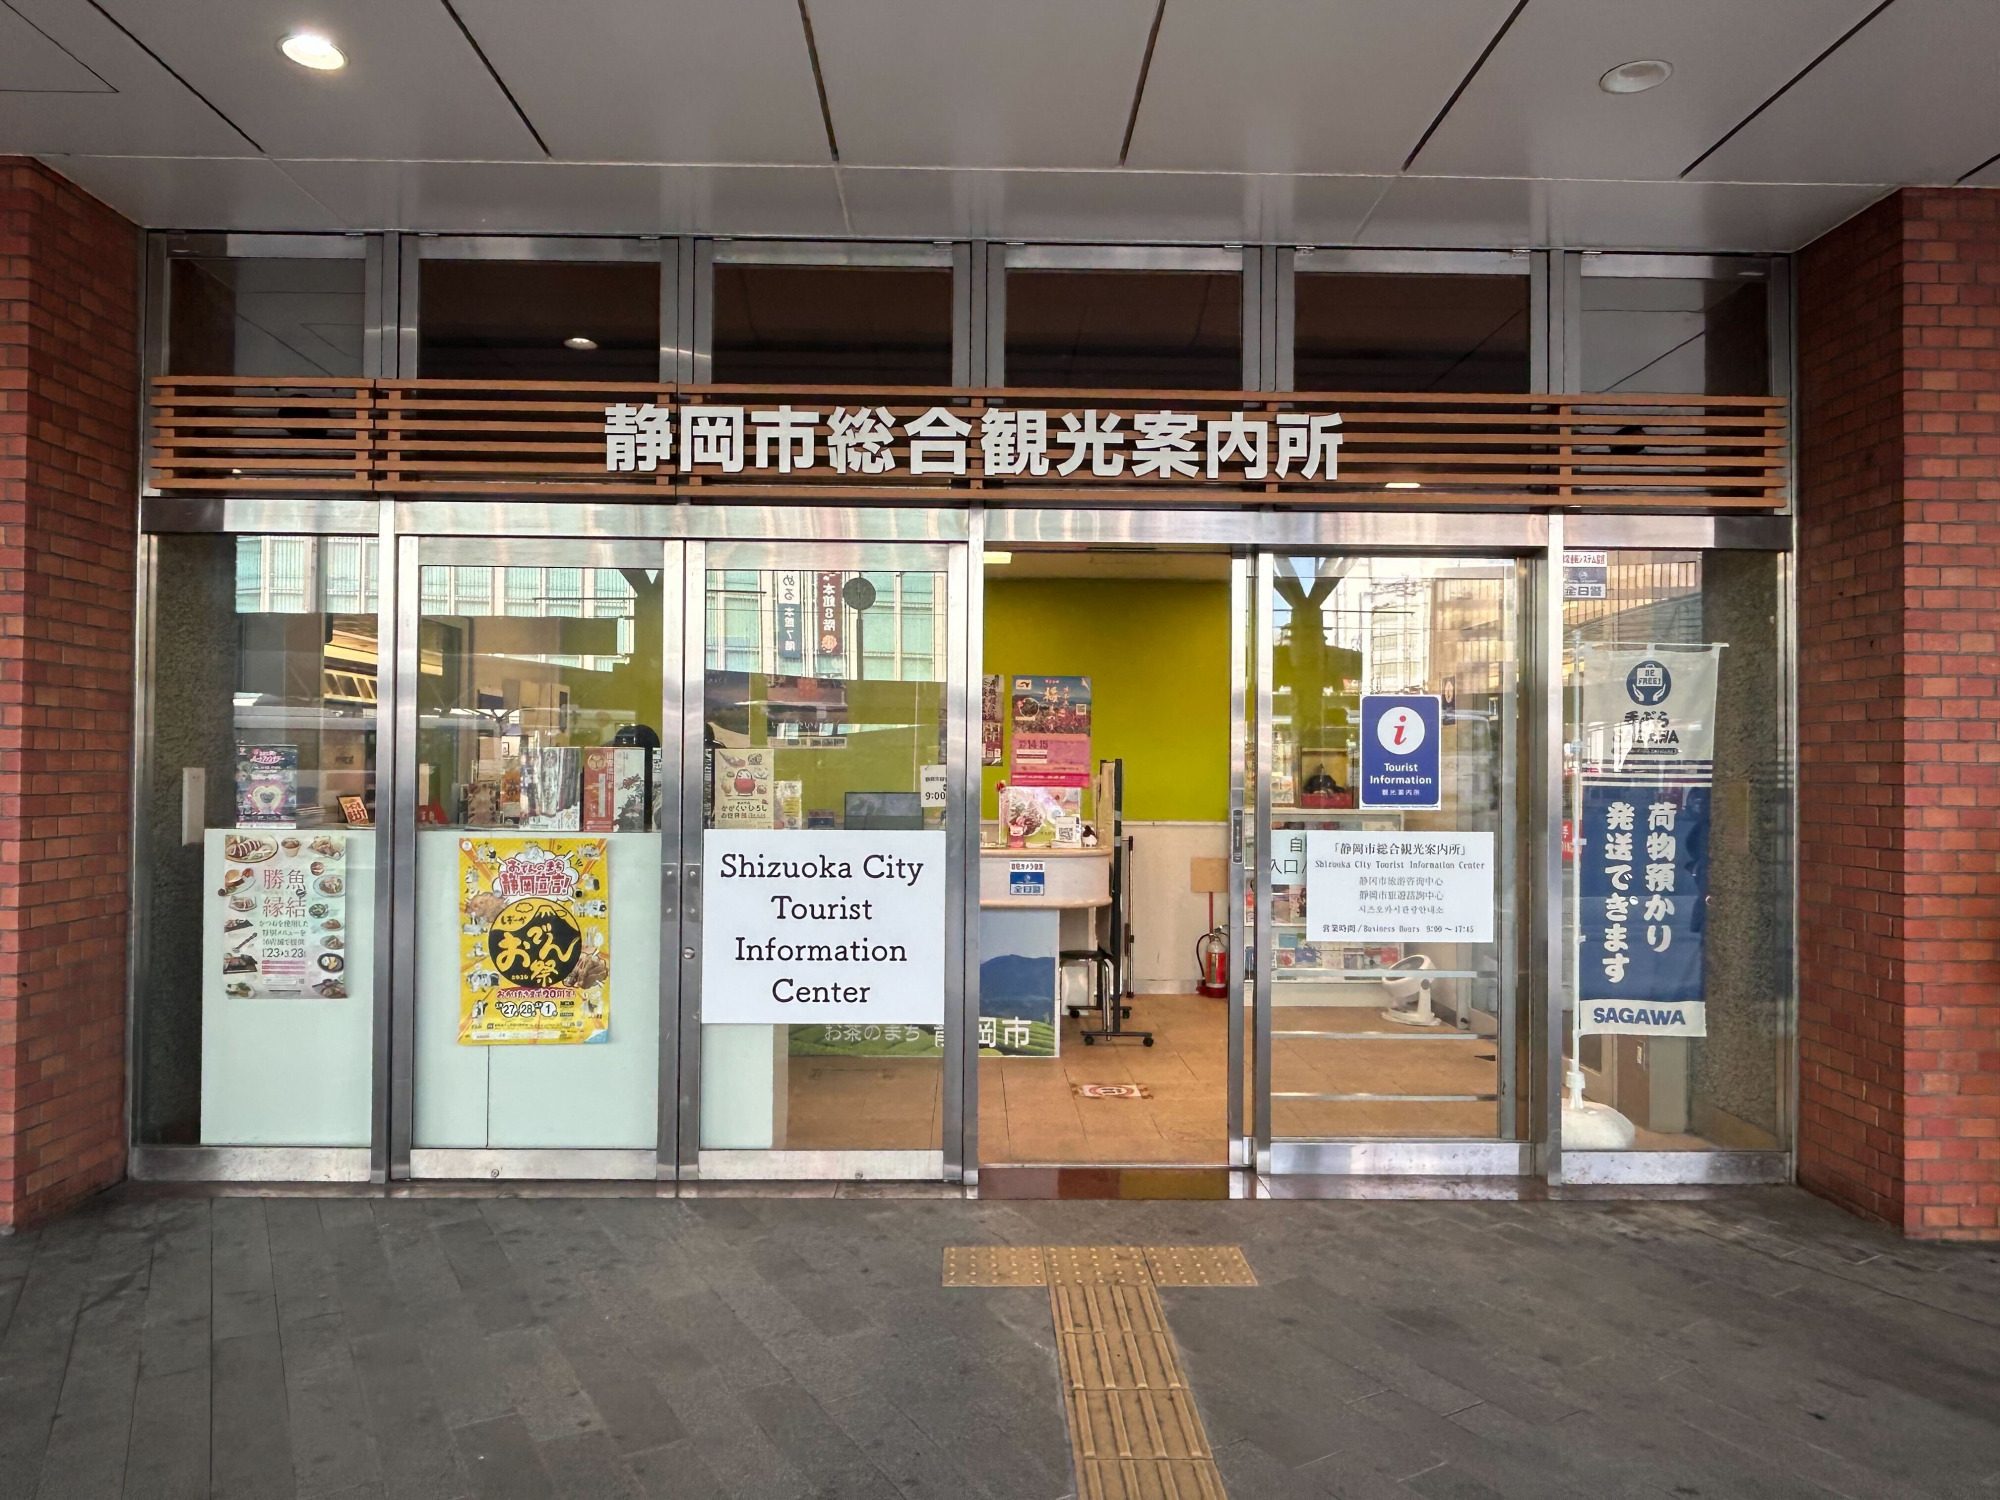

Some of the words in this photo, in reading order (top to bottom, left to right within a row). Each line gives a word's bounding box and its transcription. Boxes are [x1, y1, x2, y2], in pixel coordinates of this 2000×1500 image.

[604, 403, 1343, 481] 静岡市総合観光案内所
[1383, 762, 1418, 772] Tourist
[1369, 774, 1432, 785] Information
[925, 791, 946, 801] 9:00
[506, 859, 565, 875] おでんのまち
[720, 853, 852, 878] Shizuoka
[863, 854, 924, 887] City
[1354, 860, 1372, 870] City
[1375, 860, 1405, 869] Tourist
[1409, 860, 1455, 869] Information
[1458, 861, 1485, 870] Center
[1643, 801, 1677, 953] 荷物預かり
[1602, 801, 1635, 983] 発送できます
[771, 895, 873, 920] Tourist
[735, 936, 908, 962] Information
[771, 978, 871, 1003] Center
[503, 1003, 515, 1014] 27
[521, 1003, 533, 1014] 28
[1593, 1007, 1686, 1026] SAGAWA
[824, 1024, 920, 1042] お茶のまち
